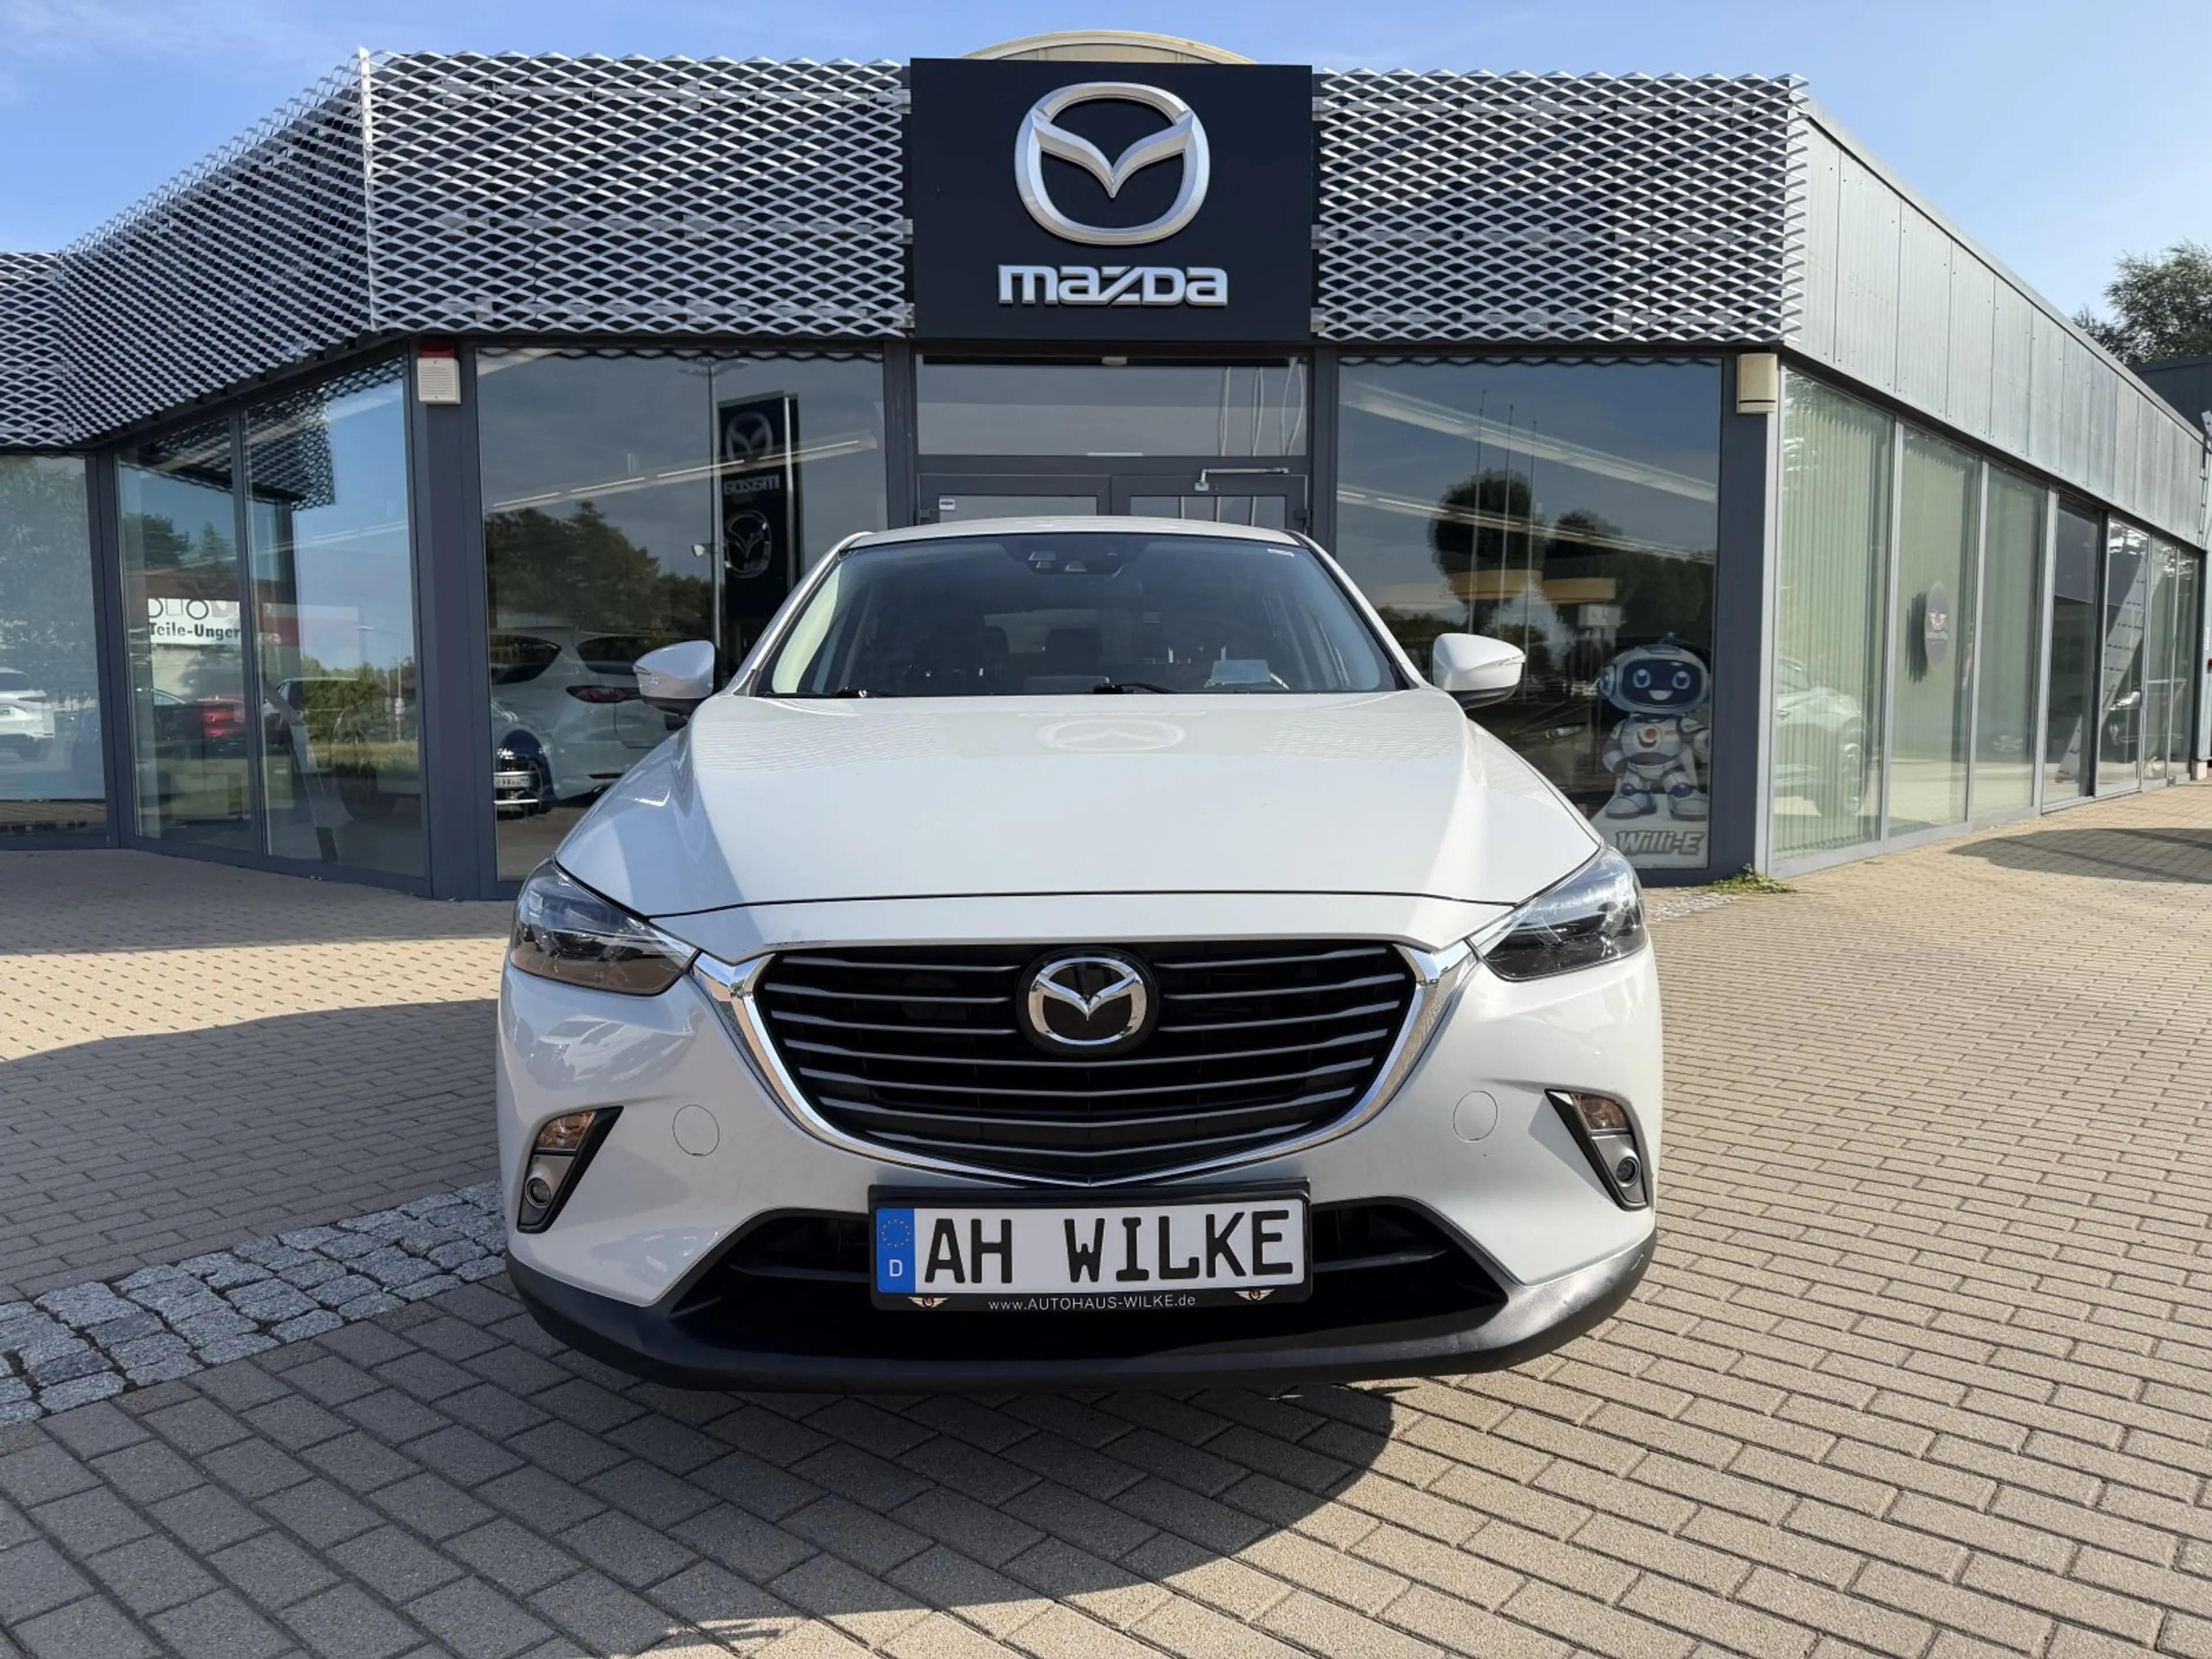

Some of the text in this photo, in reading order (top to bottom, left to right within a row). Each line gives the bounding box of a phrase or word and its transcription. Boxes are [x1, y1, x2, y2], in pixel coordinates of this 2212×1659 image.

[1615, 830, 1705, 856] Willi-E
[925, 1210, 1293, 1283] AH WILKE
[889, 1259, 903, 1277] D
[988, 1294, 1196, 1310] www.AUTOHAUS-WILKE.de
